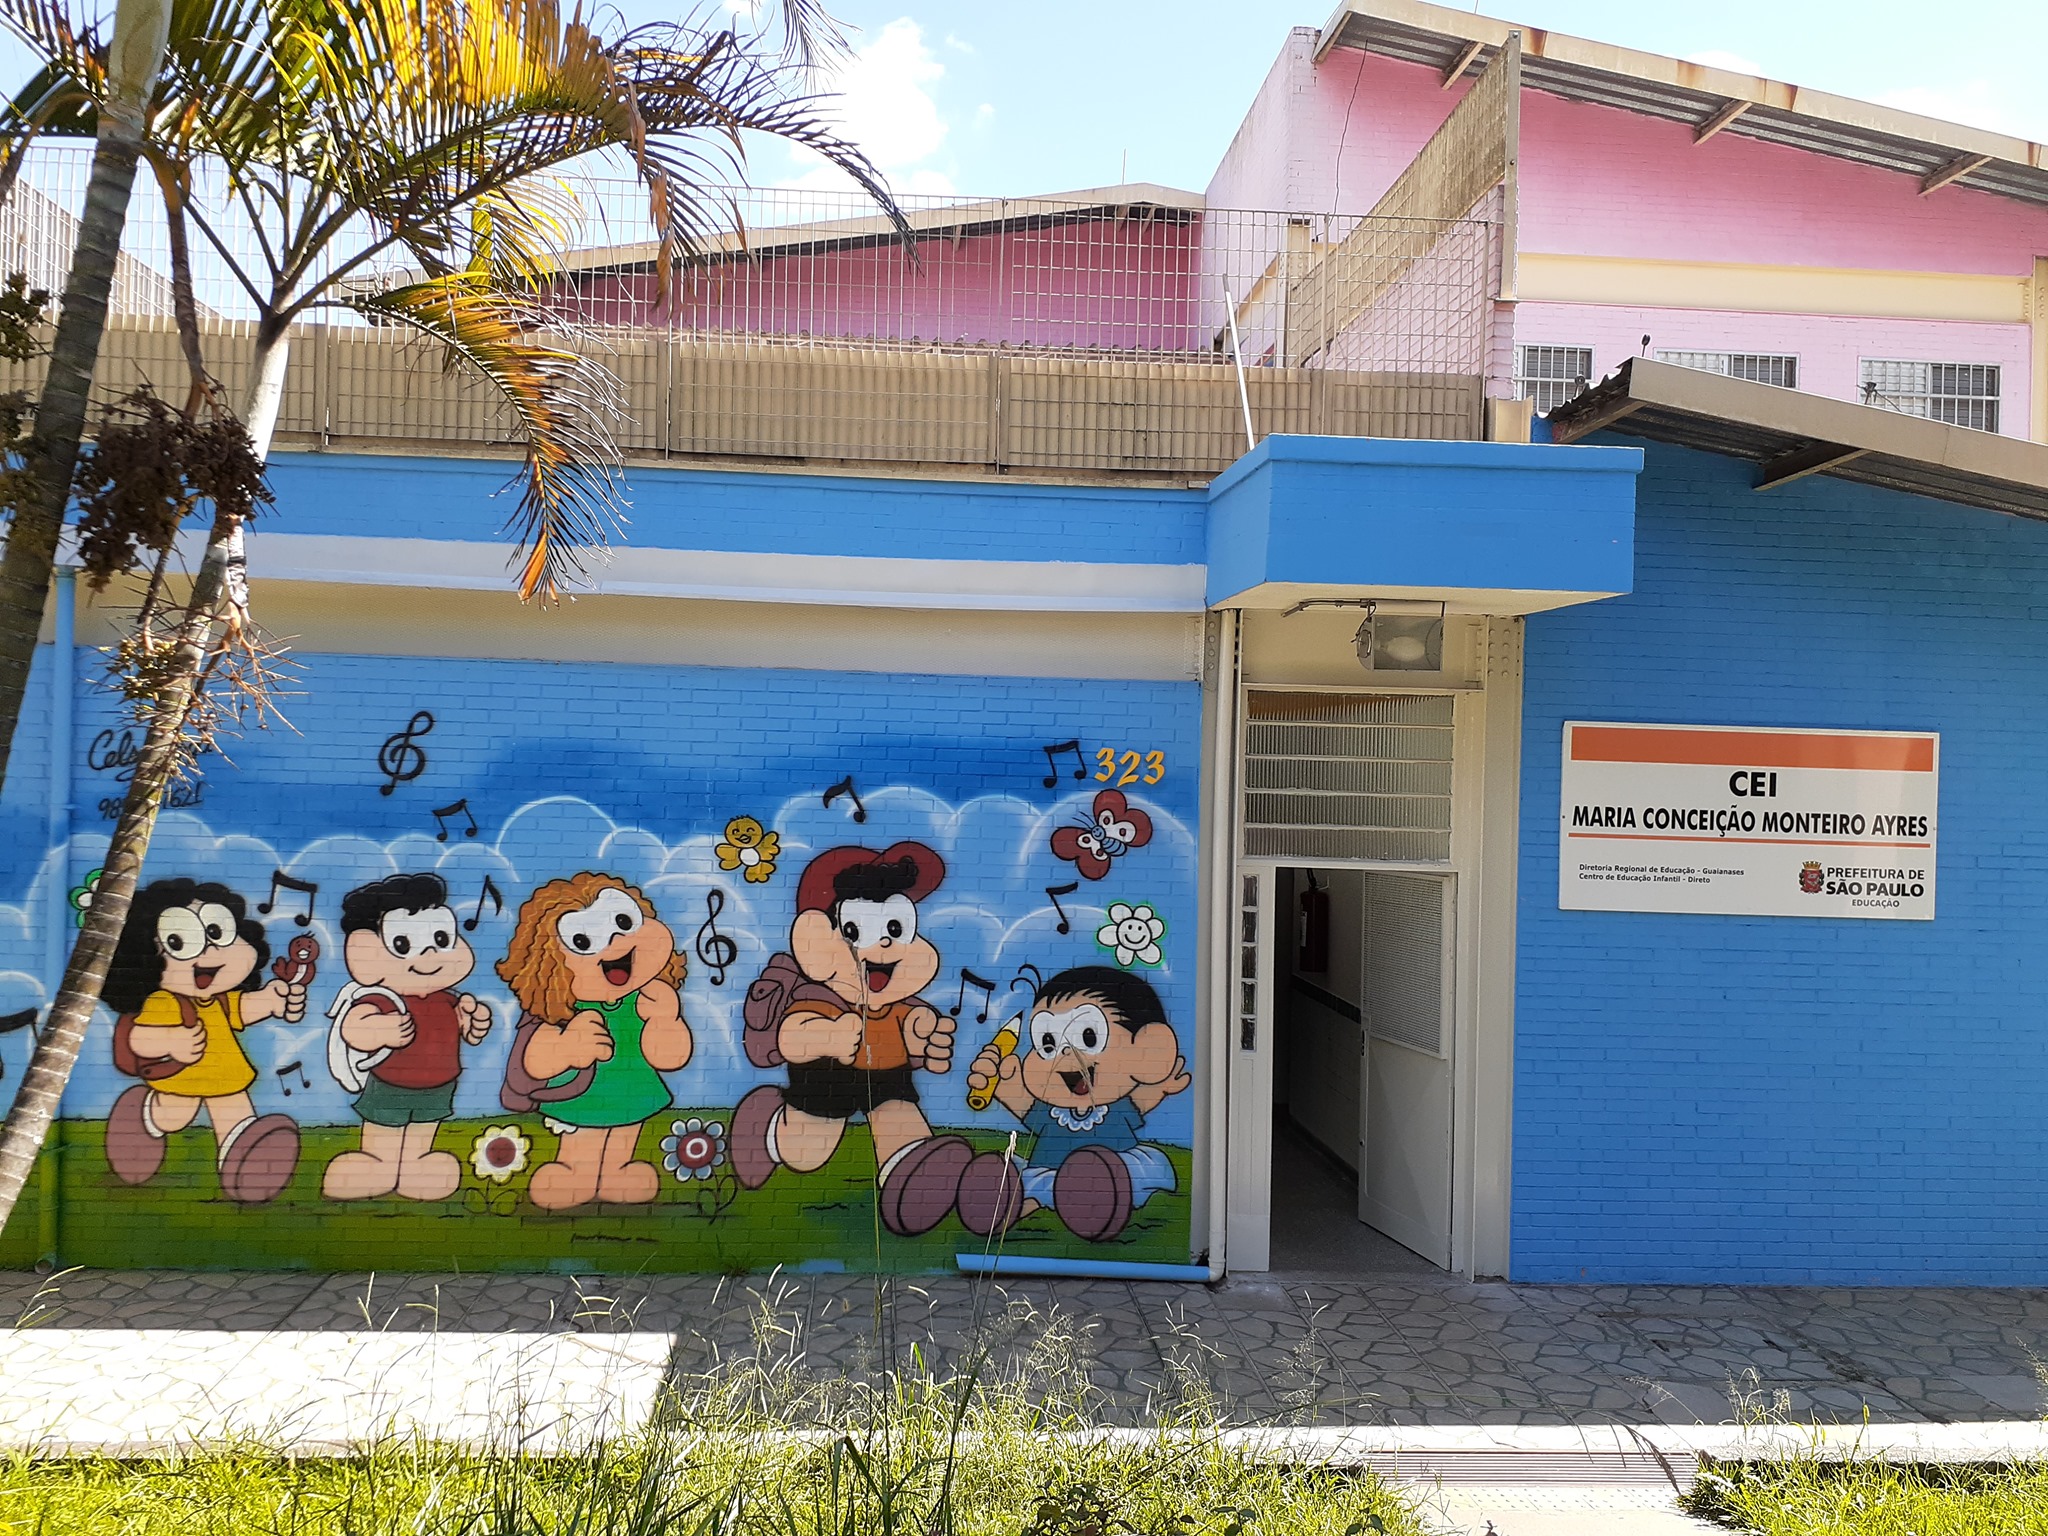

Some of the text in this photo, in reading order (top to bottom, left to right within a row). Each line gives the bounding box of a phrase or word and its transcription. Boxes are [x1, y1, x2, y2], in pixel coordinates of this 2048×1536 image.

[1094, 747, 1165, 788] 323
[1729, 771, 1777, 798] CEI
[1572, 804, 1928, 837] MARIA CONCEIÇÃO MONTEIRO AYRES
[1615, 865, 1647, 873] Regional
[1660, 867, 1695, 875] Educação
[1827, 867, 1924, 880] PREFEITURA DE
[1617, 874, 1651, 882] Educação
[1826, 879, 1924, 897] SÃO PAULO
[1852, 899, 1900, 908] EDUCAÇÃO
